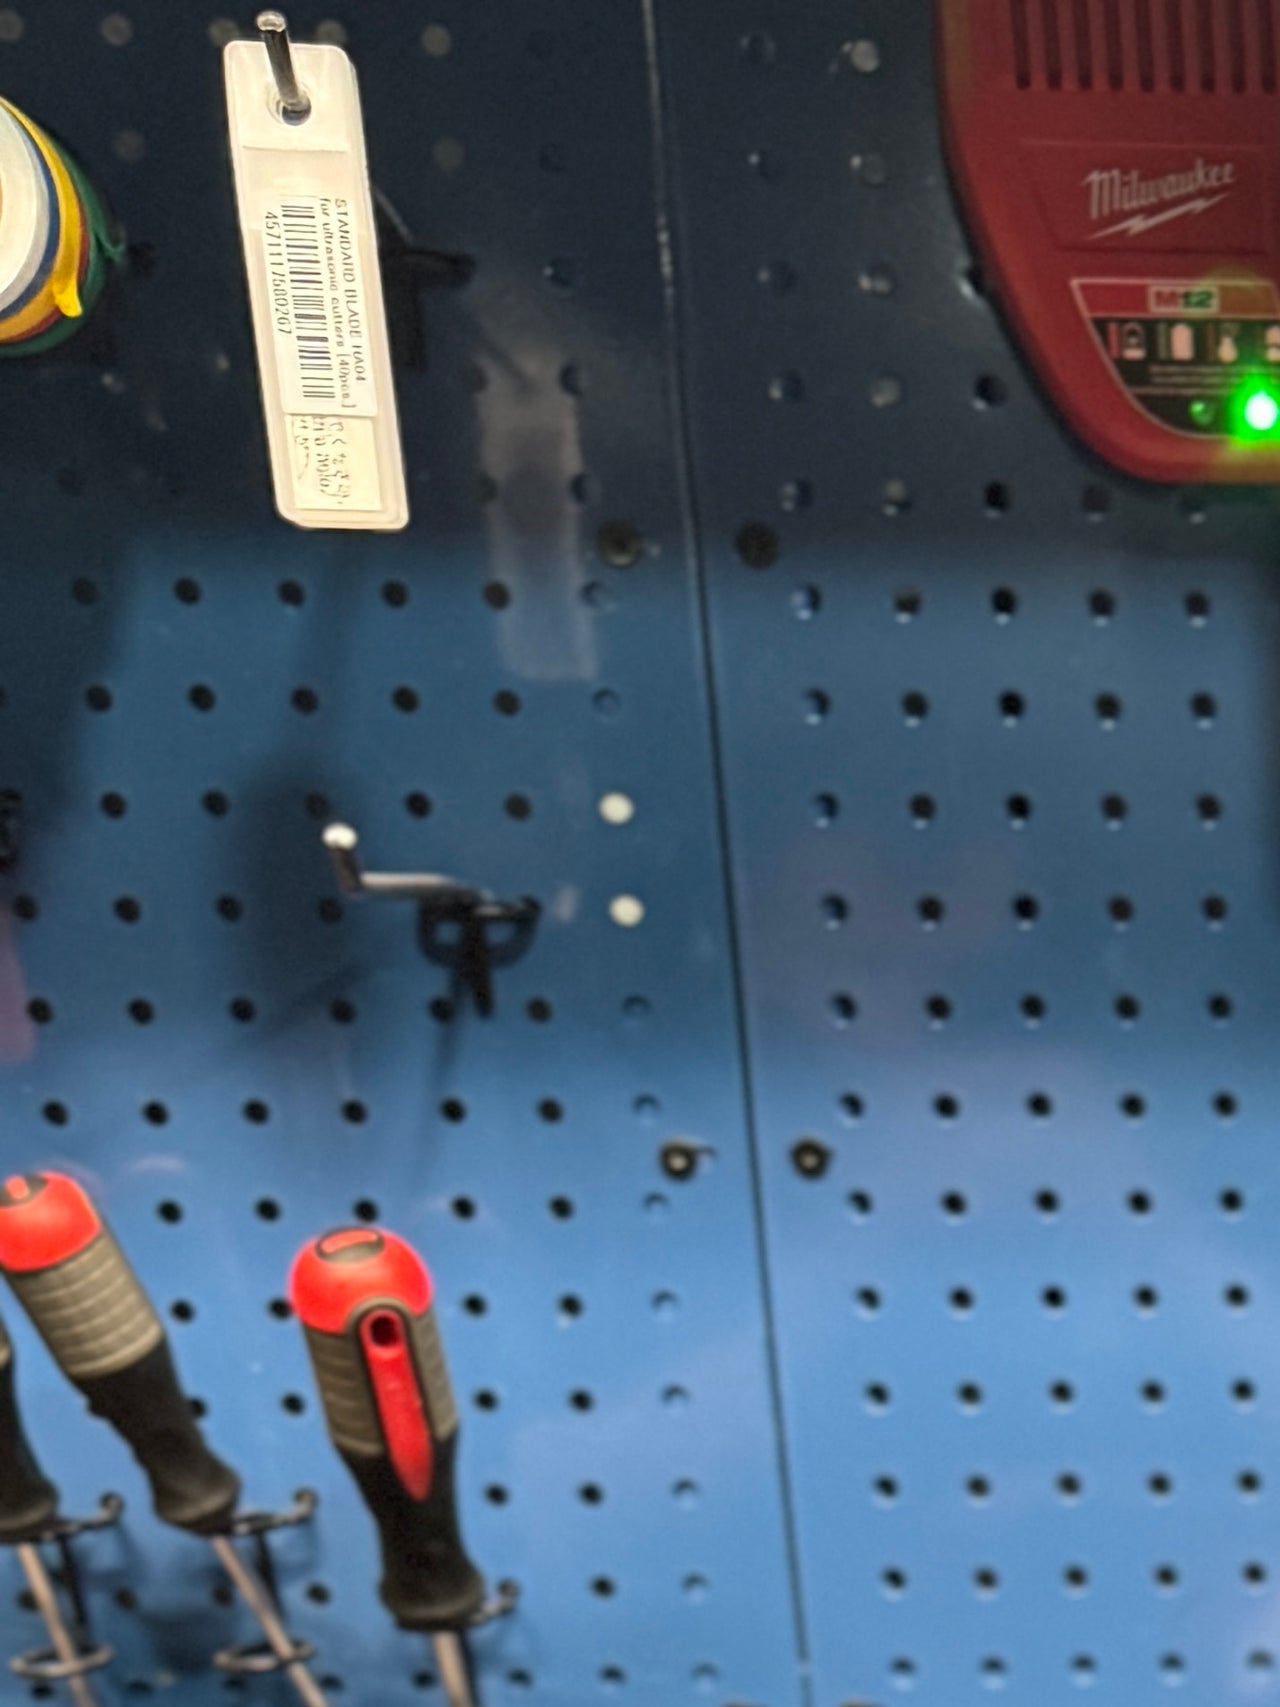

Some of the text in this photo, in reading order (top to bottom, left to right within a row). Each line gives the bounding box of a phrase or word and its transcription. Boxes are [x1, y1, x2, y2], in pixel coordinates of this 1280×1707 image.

[319, 197, 333, 217] for
[1079, 157, 1238, 221] Milwaukee
[321, 222, 339, 292] ultrasonic
[335, 198, 356, 284] STANDARD
[331, 296, 345, 348] cutters
[344, 288, 363, 338] BLADE
